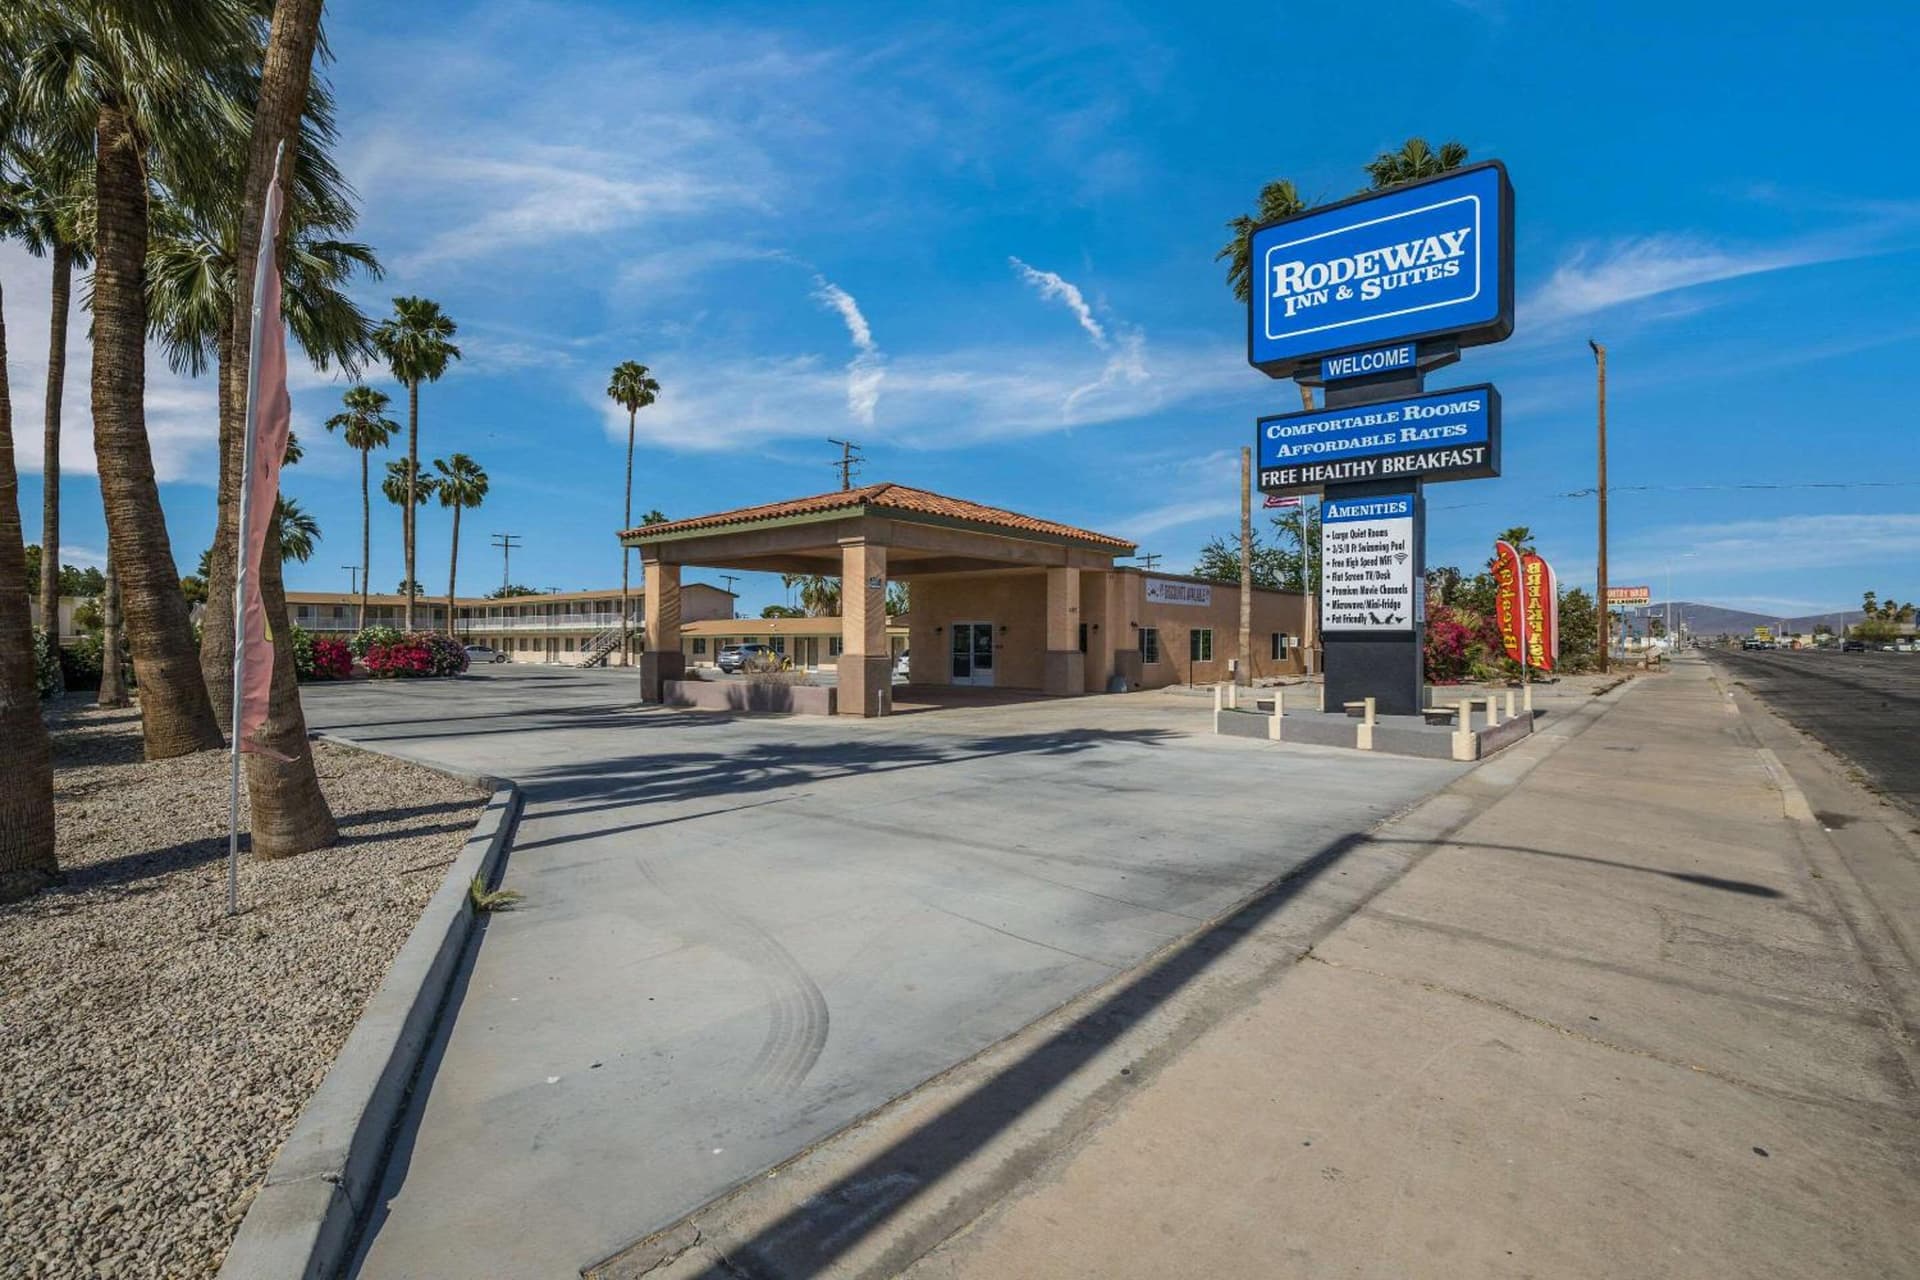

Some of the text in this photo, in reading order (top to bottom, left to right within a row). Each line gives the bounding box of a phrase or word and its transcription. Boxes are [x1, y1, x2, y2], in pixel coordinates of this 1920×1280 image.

[1272, 227, 1471, 298] RODEWAY
[1284, 259, 1460, 317] INN & SUITES
[1328, 348, 1409, 376] WELCOME
[1266, 399, 1480, 440] COMFORTABLE ROOMS
[1276, 424, 1468, 458] AFFORDABLE RATES
[1261, 448, 1486, 487] FREE HEALTHY BREAKFAST
[1327, 501, 1407, 518] AMENITIES
[1332, 528, 1388, 541] Large Quiet Rooms
[1358, 542, 1389, 553] Swimming
[1391, 539, 1405, 550] Pool
[1332, 558, 1344, 568] Free
[1346, 557, 1359, 569] High
[1360, 556, 1378, 568] Speed
[1332, 572, 1343, 582] Flat
[1345, 572, 1364, 581] Screen
[1332, 584, 1408, 596] Premium Movie Channels
[1332, 612, 1367, 625] Pet Friendly
